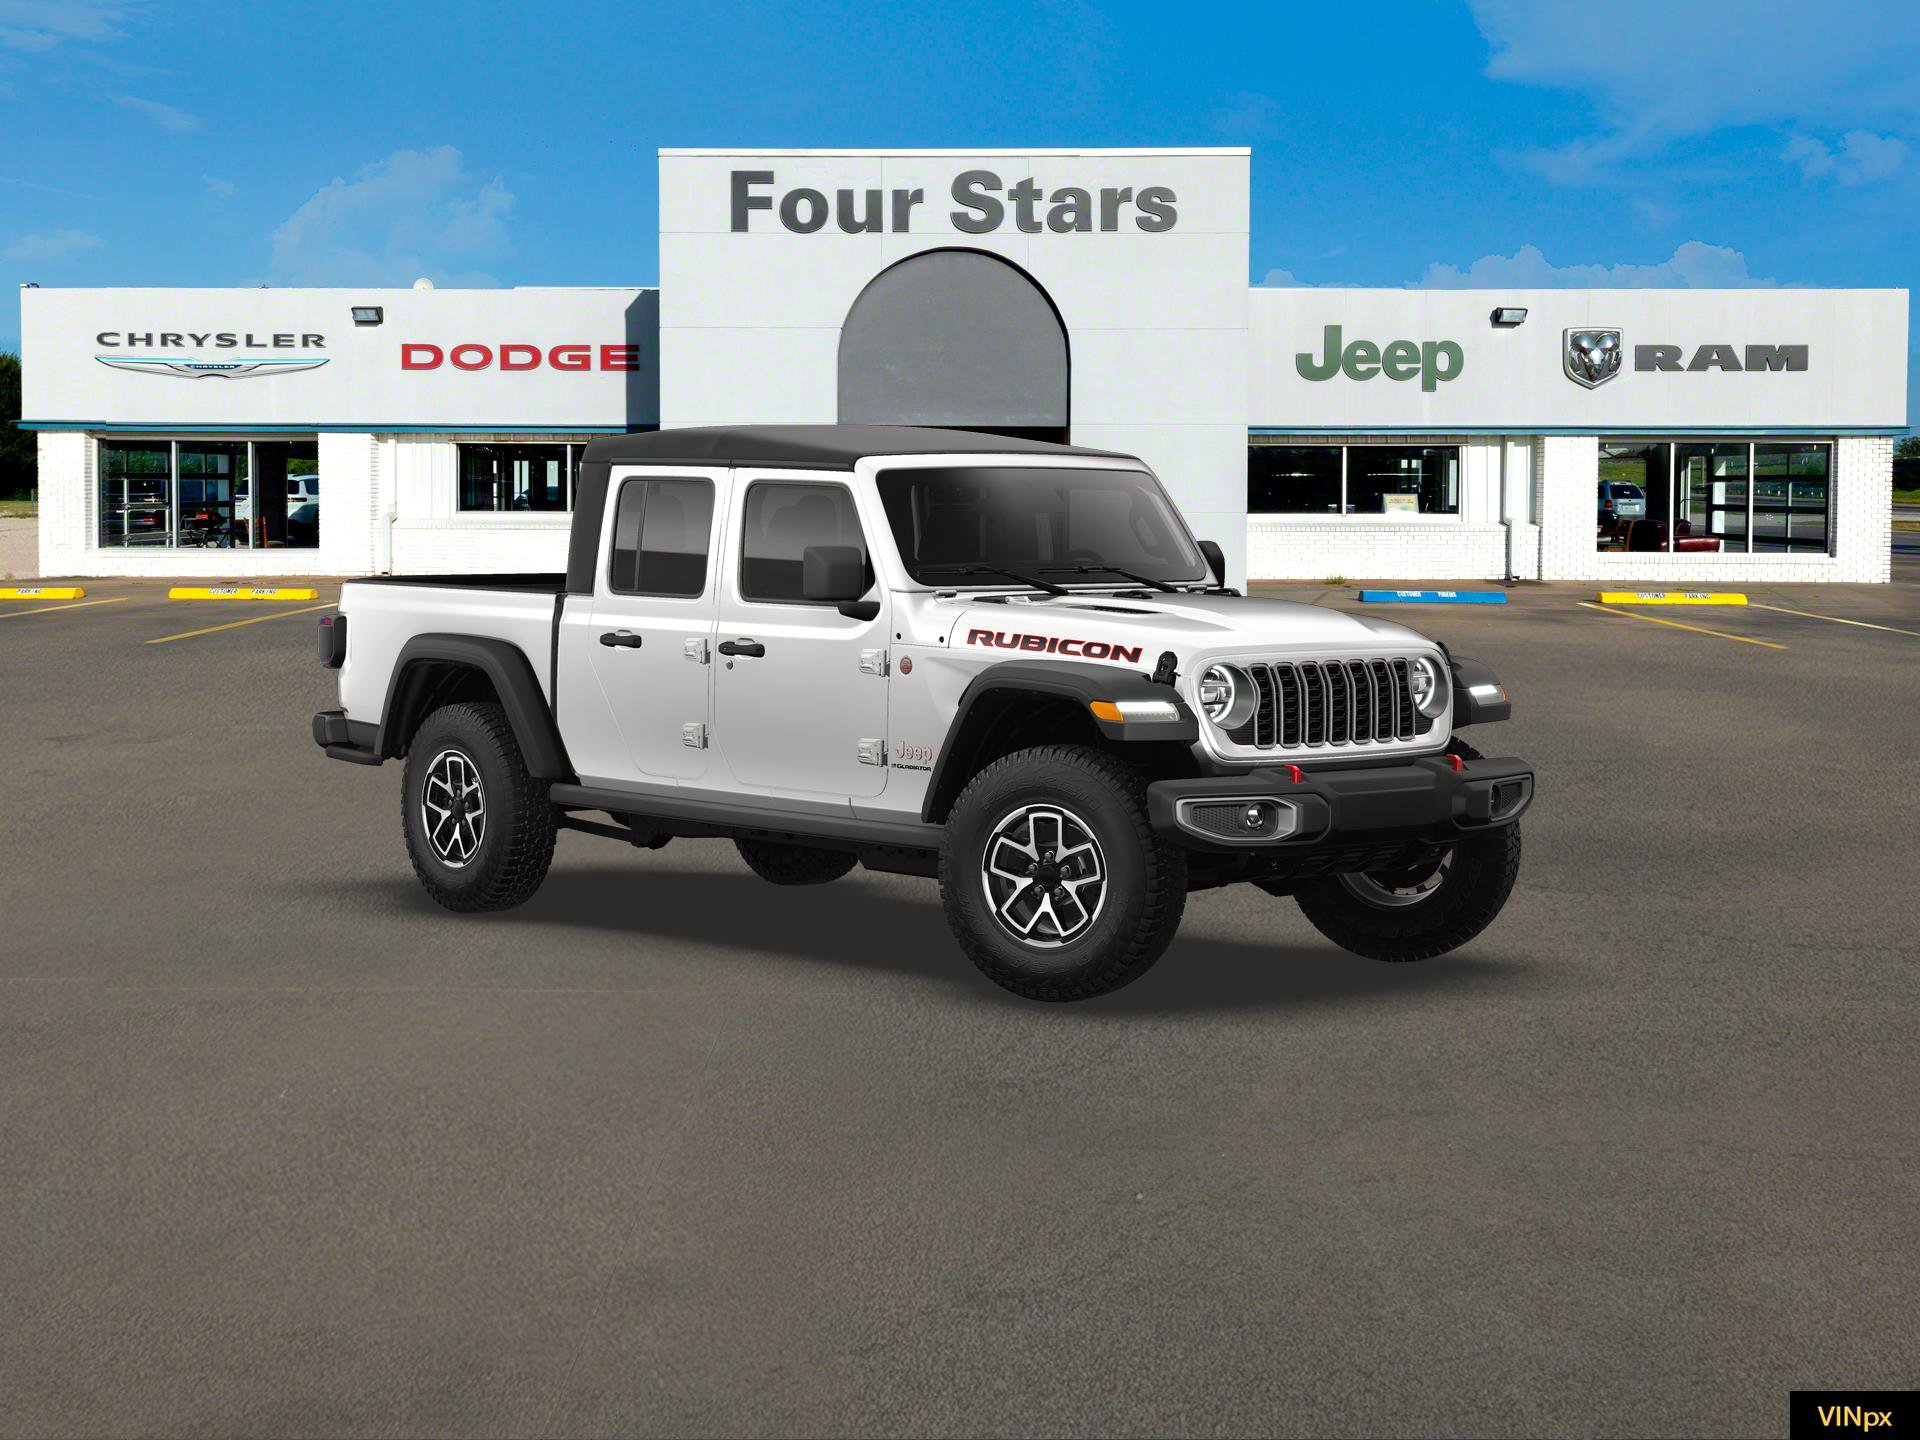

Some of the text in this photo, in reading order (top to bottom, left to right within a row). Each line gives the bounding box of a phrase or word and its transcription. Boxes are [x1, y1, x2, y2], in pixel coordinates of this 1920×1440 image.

[730, 169, 1178, 233] Four Stars
[96, 331, 327, 349] CHRYSLER
[401, 343, 641, 372] DODGE
[1295, 324, 1464, 392] Jeep
[1634, 343, 1809, 372] RAM
[966, 628, 1143, 664] RUBICON
[895, 740, 933, 765] Jeep
[896, 763, 932, 772] GLADIATOR
